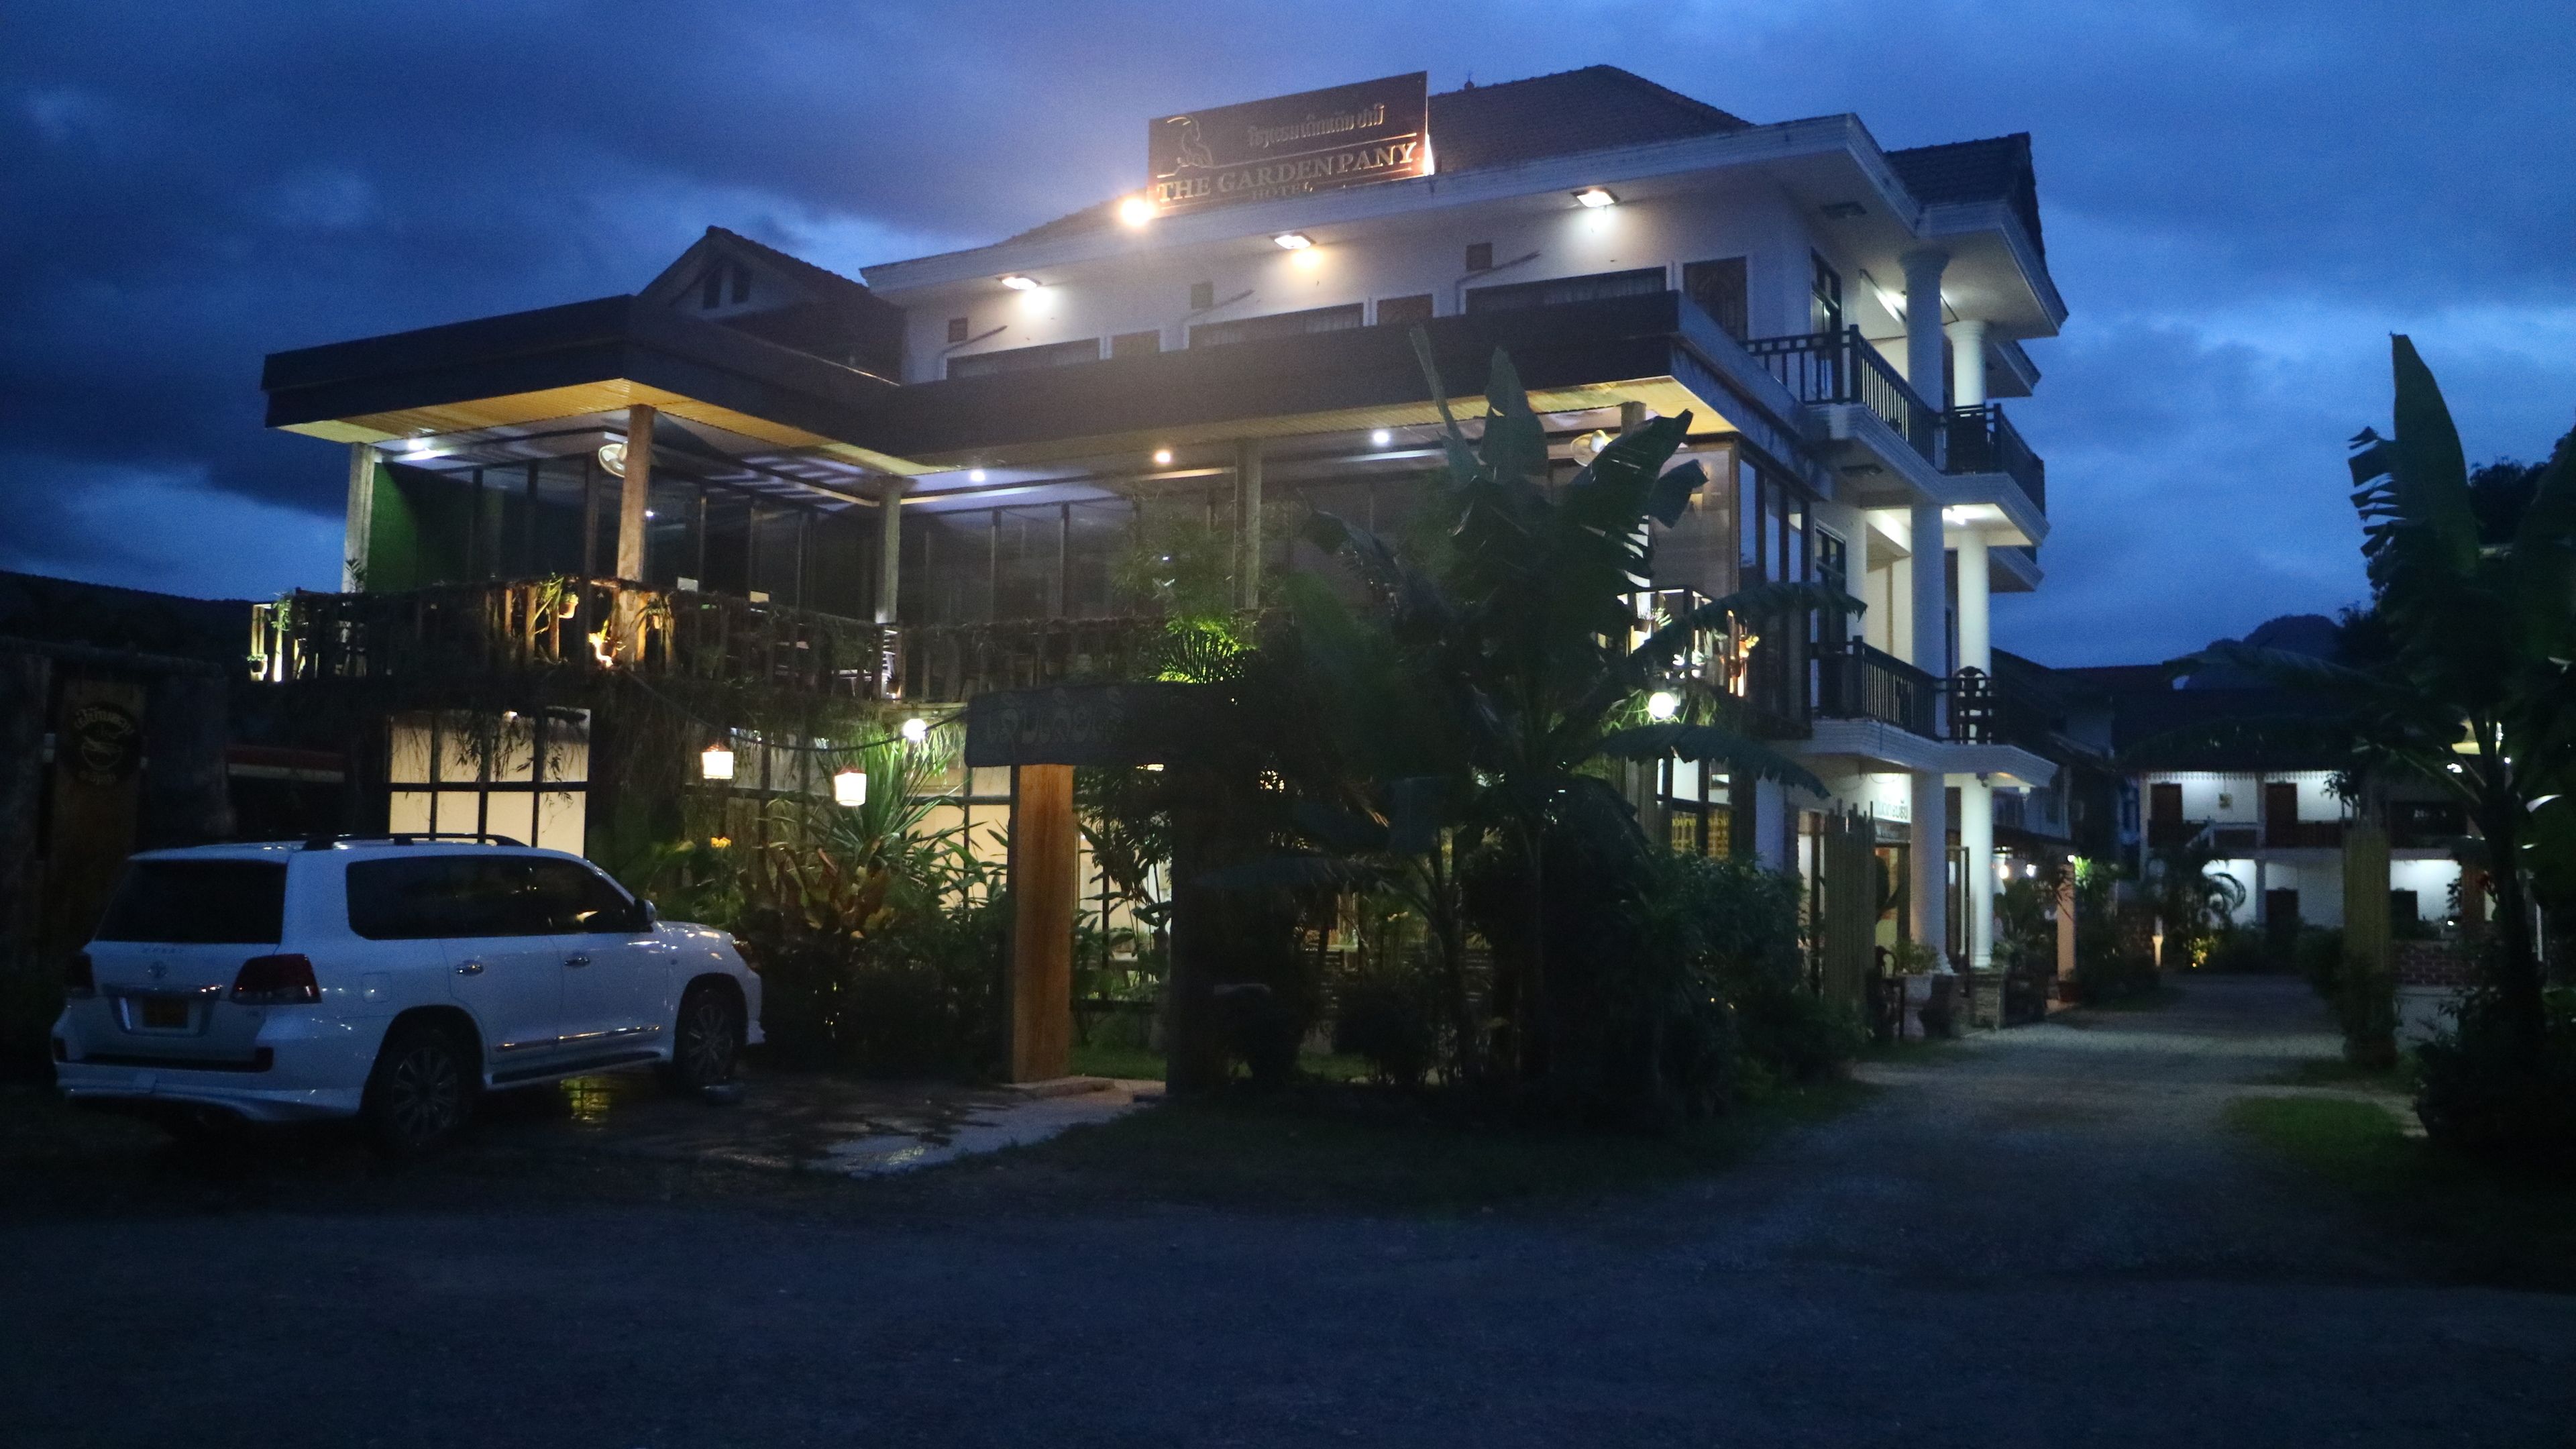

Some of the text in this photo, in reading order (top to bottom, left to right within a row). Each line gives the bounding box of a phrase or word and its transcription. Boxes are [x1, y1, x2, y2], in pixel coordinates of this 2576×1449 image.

[1159, 142, 1417, 202] THE GARDEN PANY
[1250, 180, 1313, 201] HOTEL
